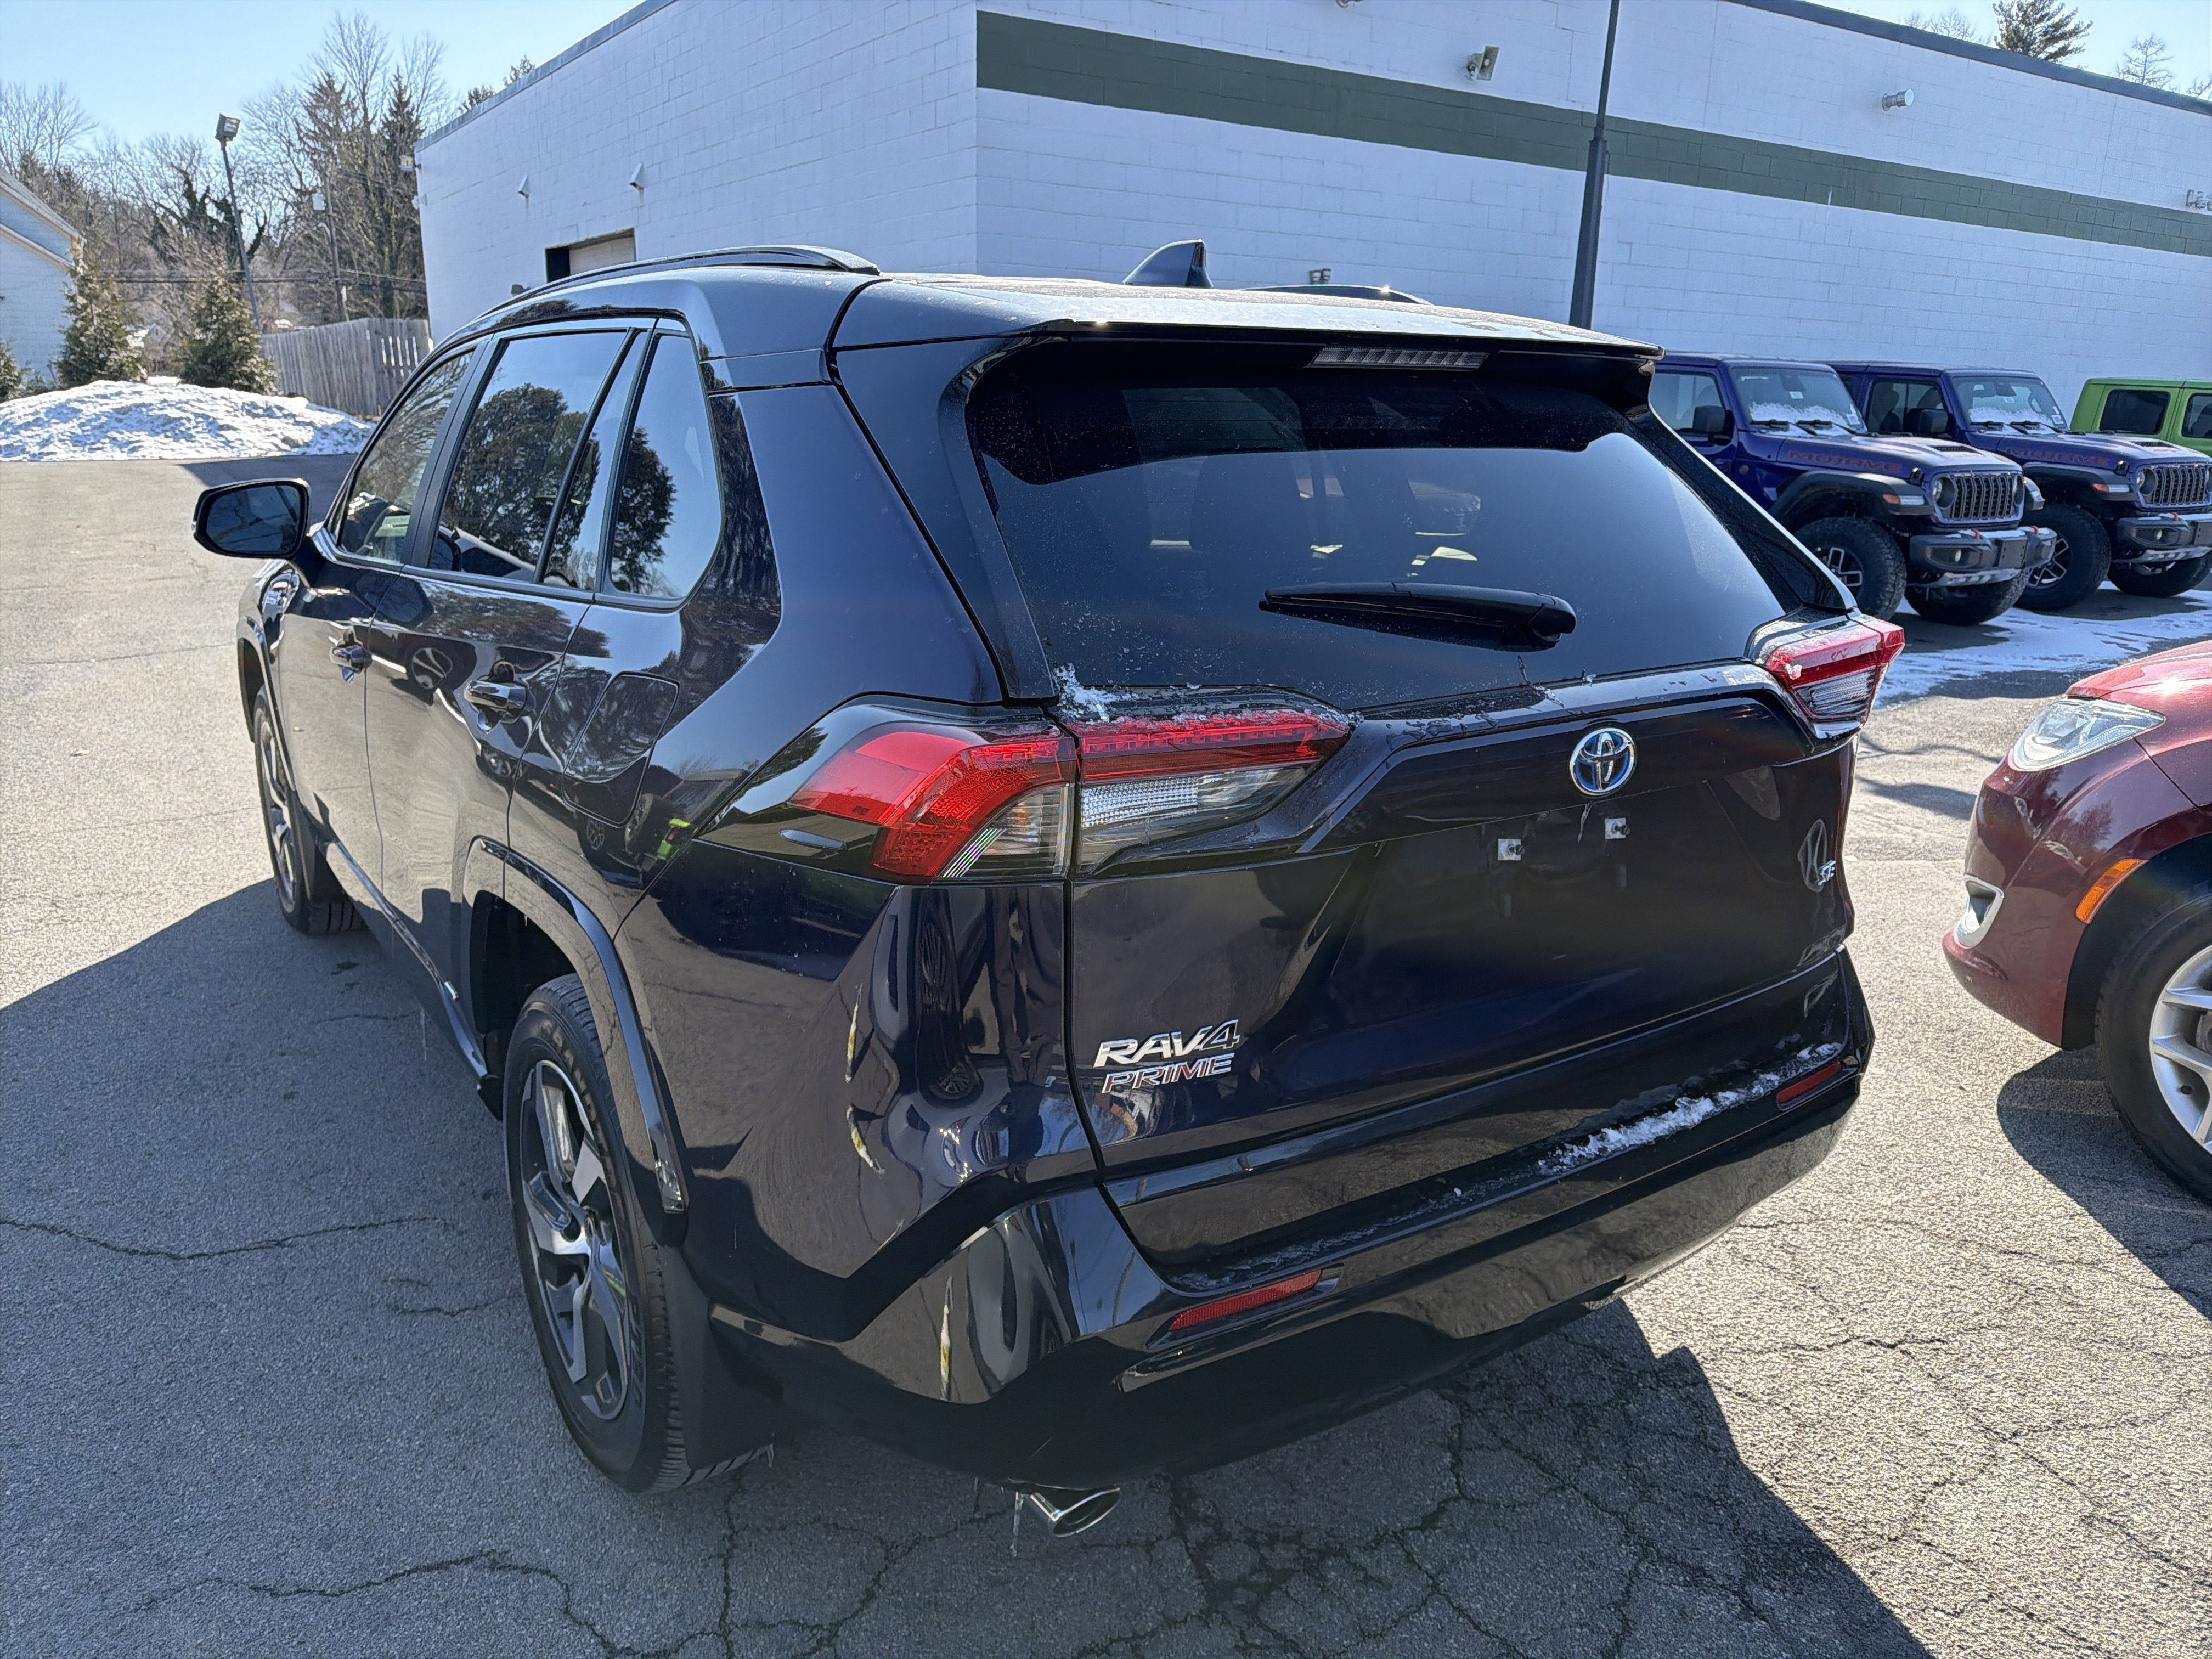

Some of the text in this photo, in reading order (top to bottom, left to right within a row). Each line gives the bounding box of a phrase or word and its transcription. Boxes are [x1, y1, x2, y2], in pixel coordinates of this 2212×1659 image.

[1788, 450, 1903, 473] MOJAVE
[1093, 1019, 1240, 1068] RAV4
[1102, 1053, 1235, 1093] PRIME
